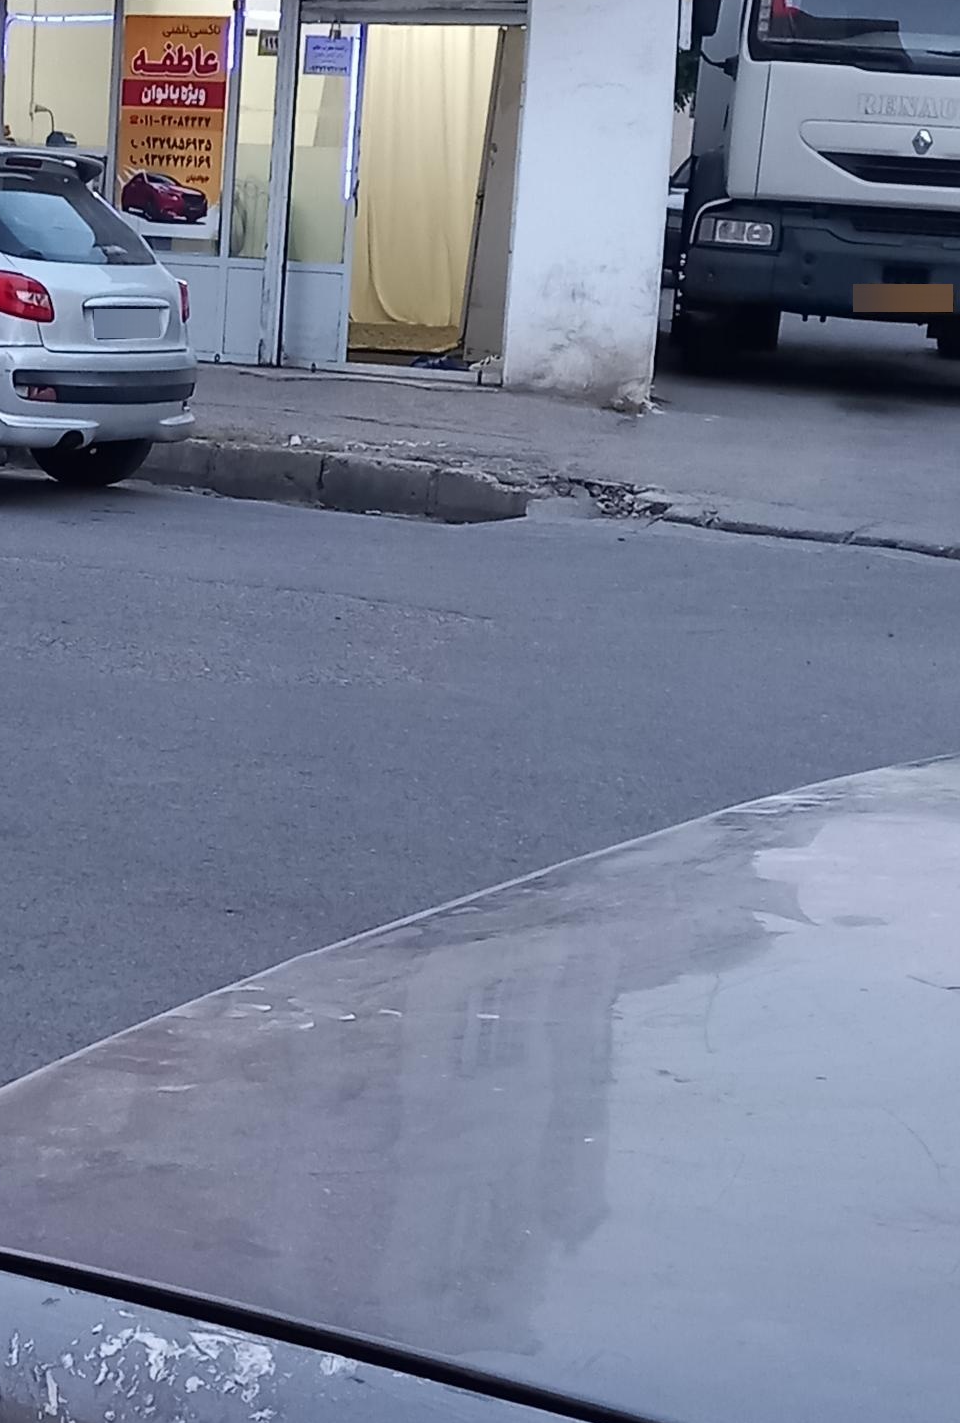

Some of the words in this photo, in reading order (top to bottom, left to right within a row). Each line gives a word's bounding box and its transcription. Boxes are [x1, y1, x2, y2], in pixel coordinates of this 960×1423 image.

[189, 23, 221, 39] تاکسی
[132, 42, 219, 75] عاطفه
[141, 83, 180, 105] بانوان
[180, 83, 206, 106] ویژه
[858, 92, 960, 119] RENAU
